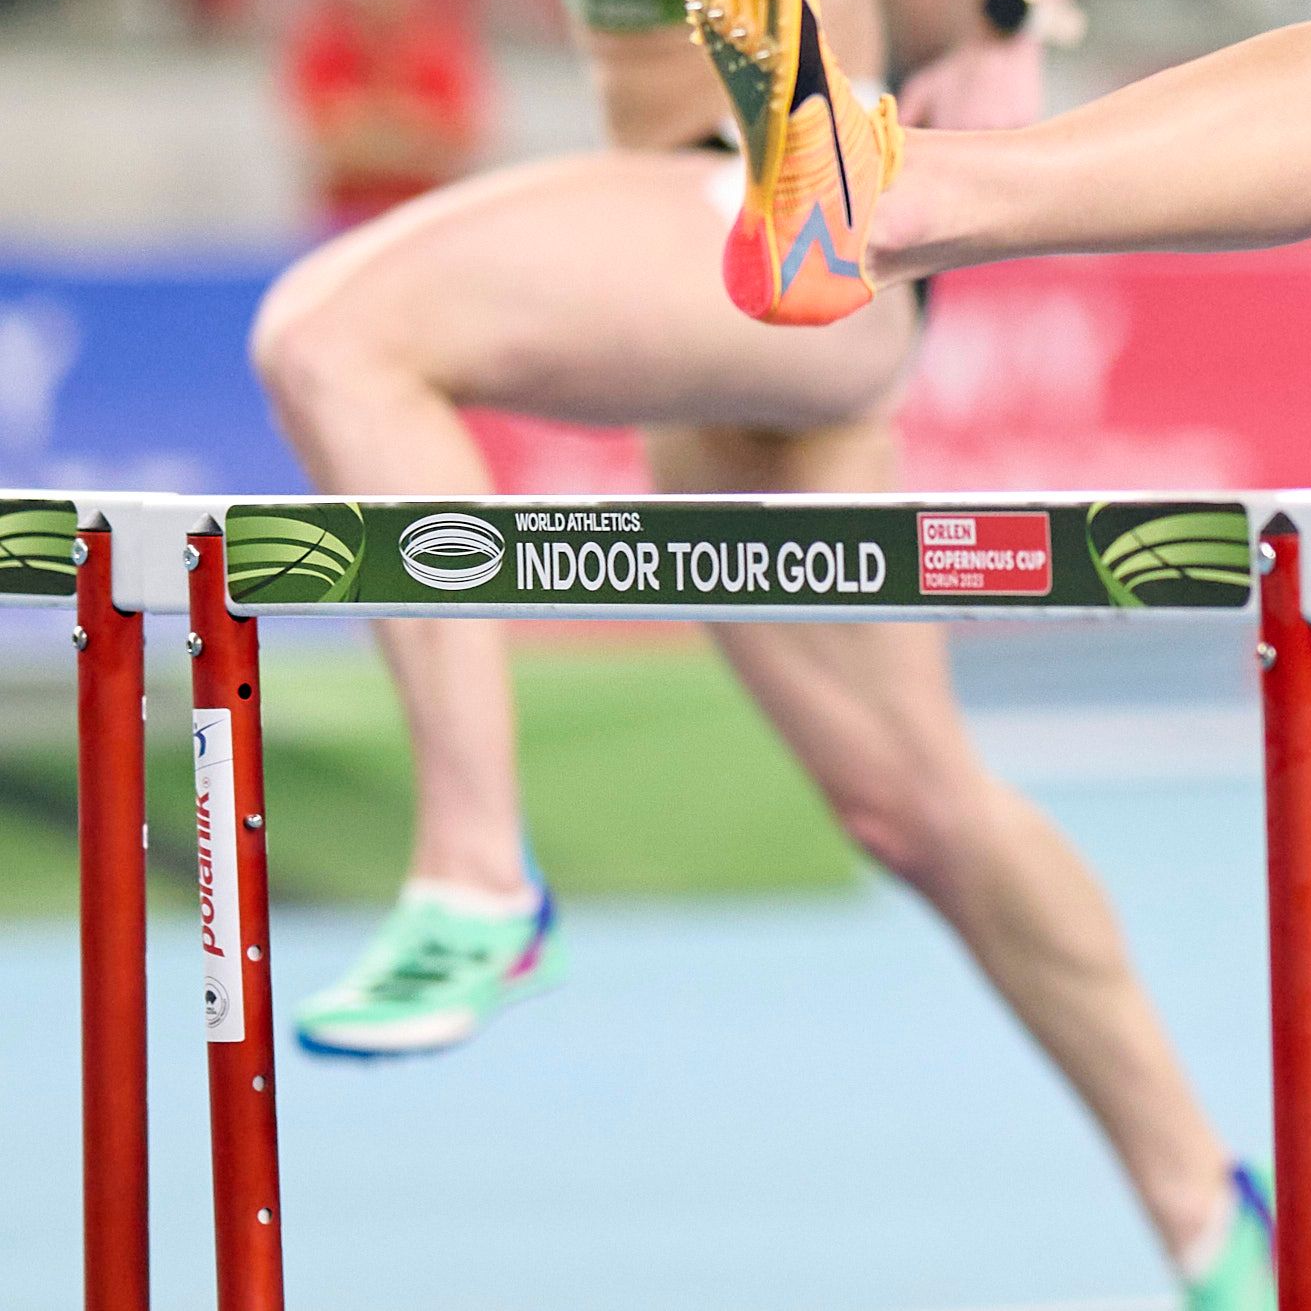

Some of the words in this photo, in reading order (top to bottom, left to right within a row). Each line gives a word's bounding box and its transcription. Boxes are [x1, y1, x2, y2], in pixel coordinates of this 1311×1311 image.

[514, 512, 566, 532] WORLD
[566, 512, 642, 532] ATHLETICS
[926, 524, 972, 540] ORLEN
[515, 540, 660, 592] INDOOR
[667, 540, 770, 593] TOUR
[776, 541, 887, 594] GOLD
[924, 549, 1015, 571] COPERNICUS
[1015, 550, 1047, 572] CUP
